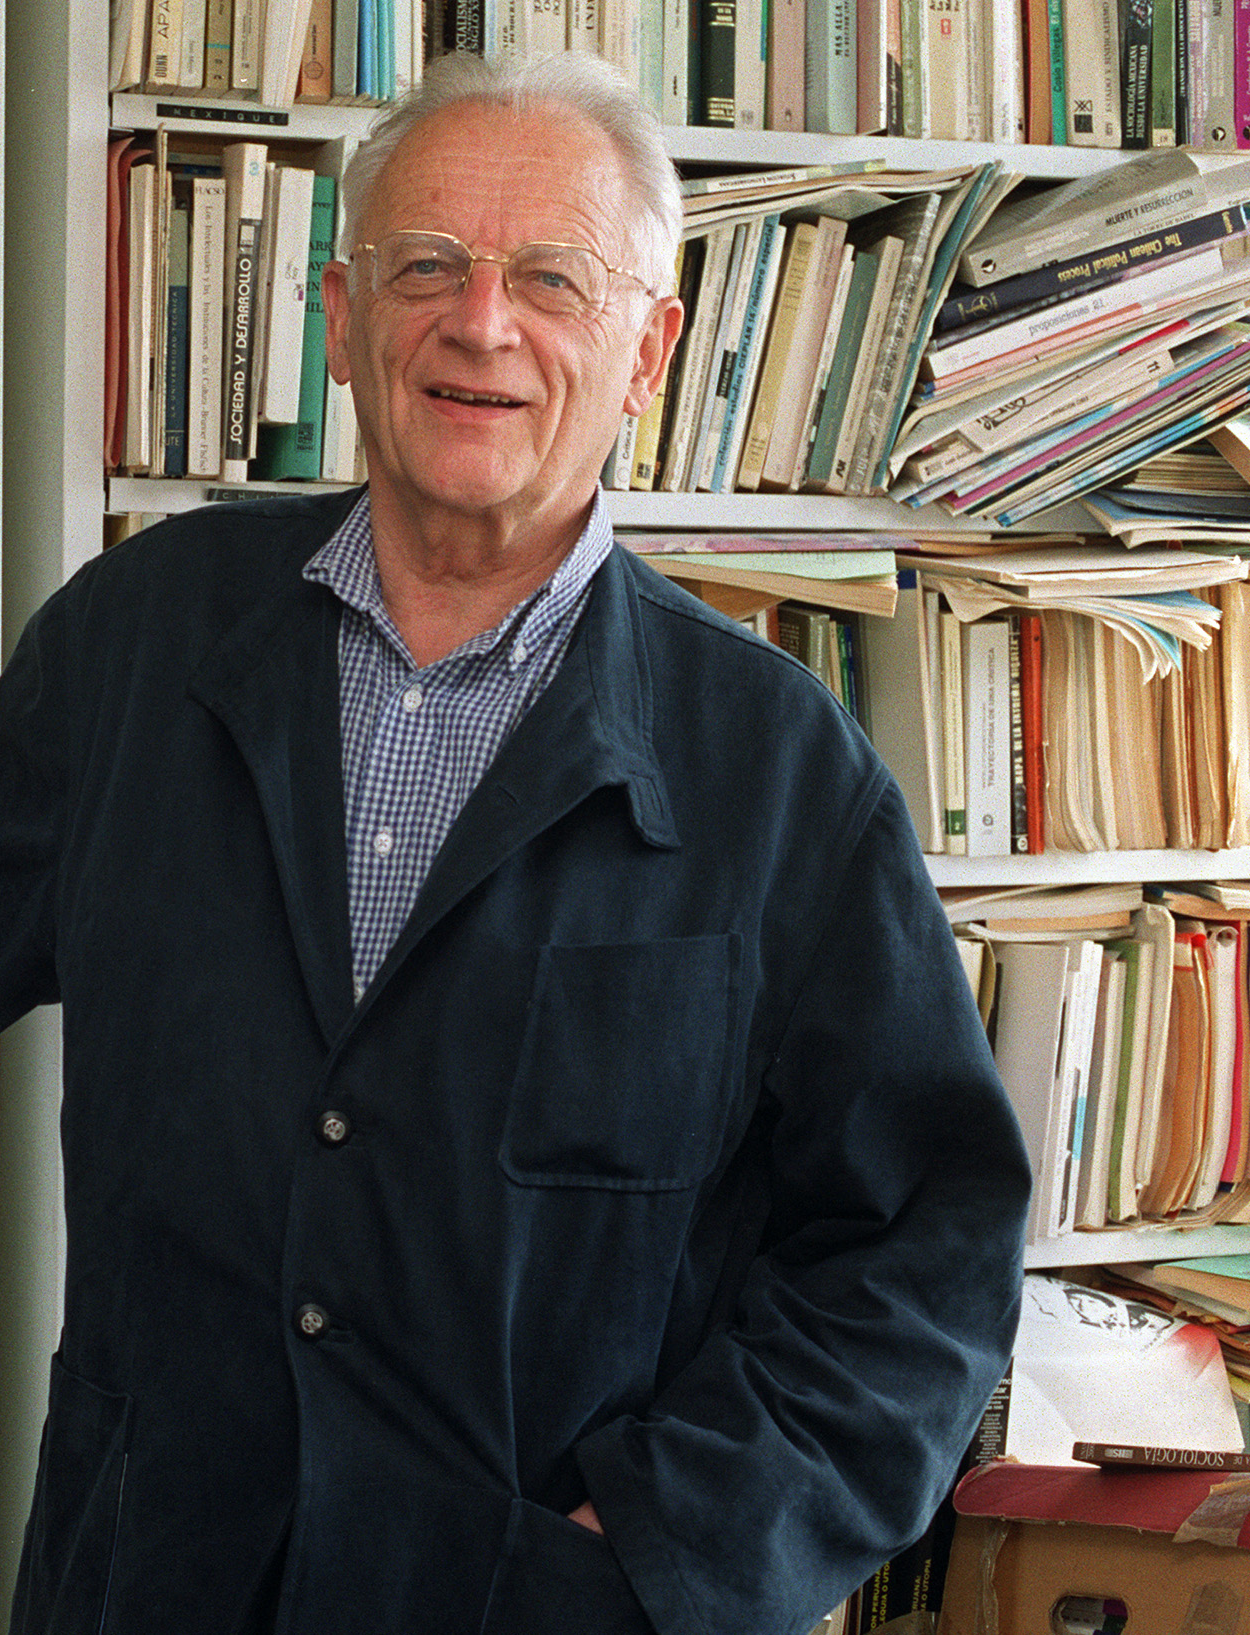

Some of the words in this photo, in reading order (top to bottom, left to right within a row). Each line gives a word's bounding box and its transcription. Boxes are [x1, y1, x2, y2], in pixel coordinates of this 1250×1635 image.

[157, 0, 169, 39] APA
[155, 55, 167, 78] DUNN
[1128, 45, 1137, 83] MEXICANA
[1138, 45, 1147, 99] UNIVERSIDAD
[1138, 101, 1145, 111] LA
[1126, 129, 1134, 138] LA
[1137, 114, 1145, 138] DESDE
[1105, 211, 1133, 226] MUERTE
[758, 224, 777, 264] especial
[1130, 238, 1162, 259] Chilean
[1165, 233, 1182, 247] The
[1057, 261, 1091, 283] Process
[1093, 247, 1129, 274] Political
[234, 258, 252, 348] DESARROLLO
[1029, 306, 1090, 336] proposiciones
[233, 354, 247, 365] Y
[736, 326, 756, 369] CIEPLAN
[727, 374, 746, 414] estudios
[229, 371, 246, 445] SOCIEDAD
[988, 709, 995, 720] DE
[1013, 726, 1022, 737] LA
[987, 722, 995, 787] TRAYECTORIA
[1014, 757, 1024, 784] MAPA
[922, 1559, 931, 1592] UTOPIA
